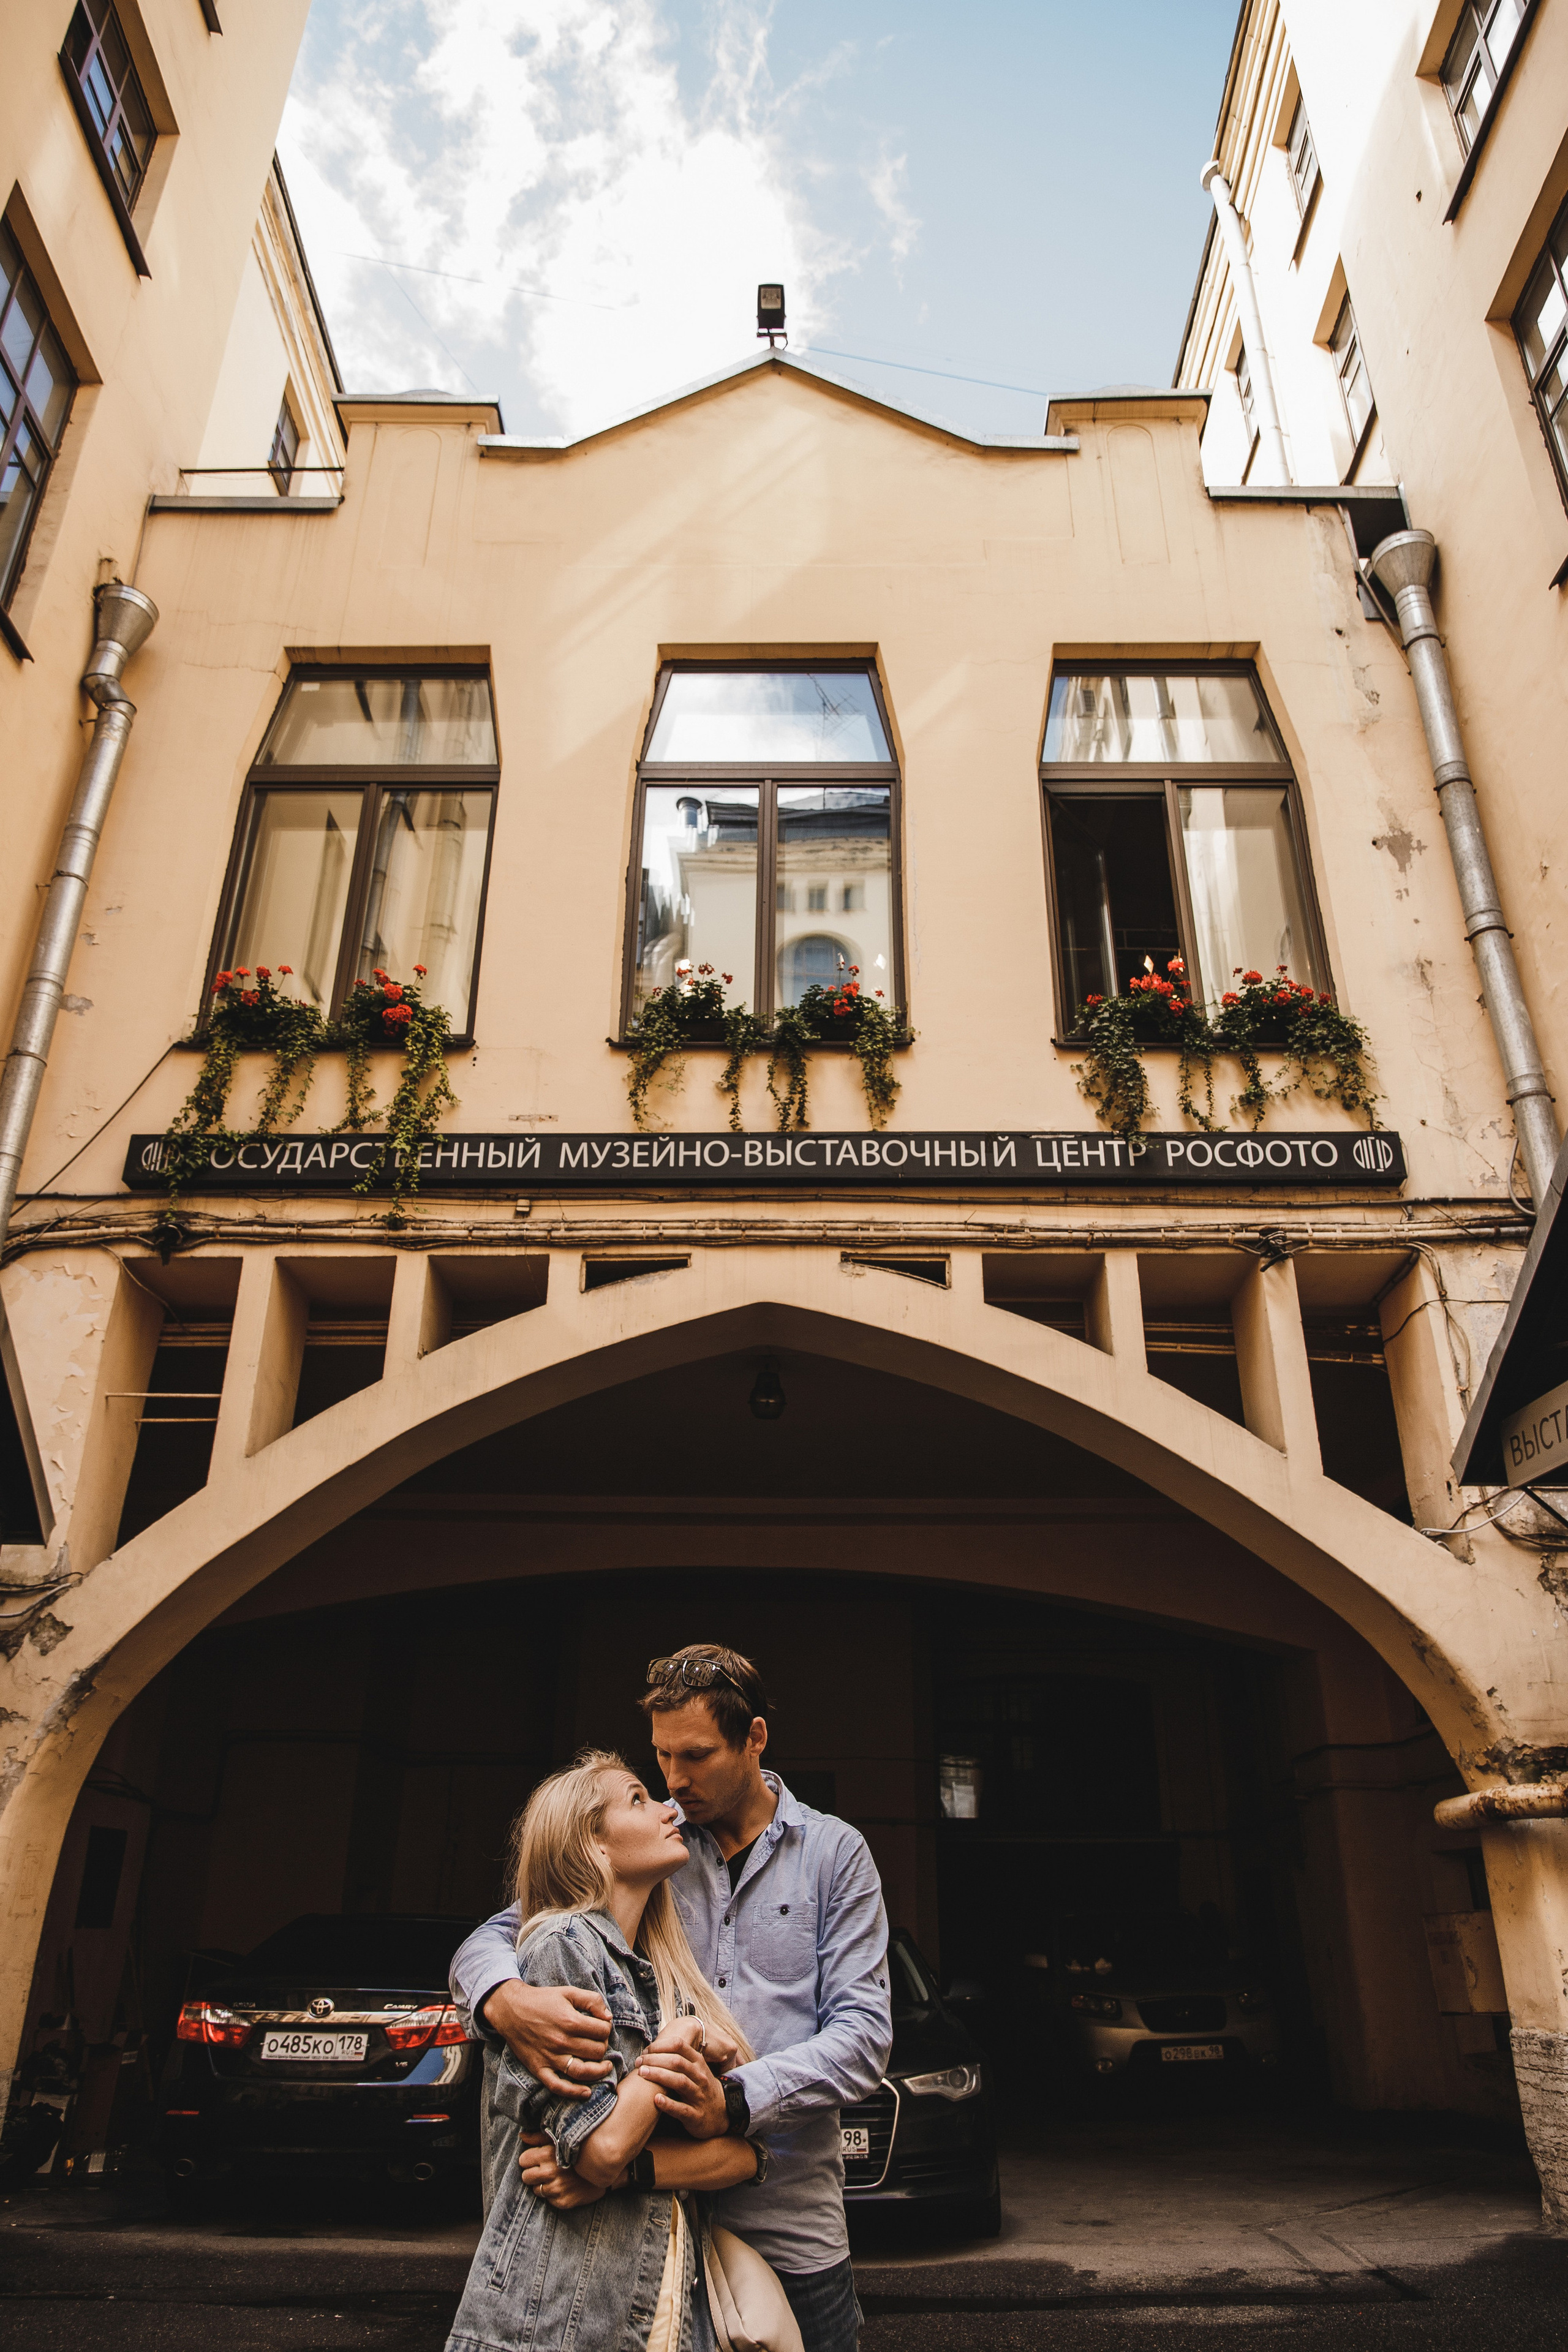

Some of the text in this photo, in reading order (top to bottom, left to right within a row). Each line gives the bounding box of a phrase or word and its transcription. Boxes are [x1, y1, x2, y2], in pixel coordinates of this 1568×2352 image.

[559, 1136, 1017, 1168] МУЗЕЙНО-ВЫСТАВОЧНЫЙ
[1036, 1140, 1147, 1172] ЦЕНТР
[1166, 1139, 1339, 1167] РОСФОТО
[1509, 1404, 1568, 1467] ВЫСТ
[338, 2035, 363, 2050] 178
[843, 2130, 862, 2146] 98
